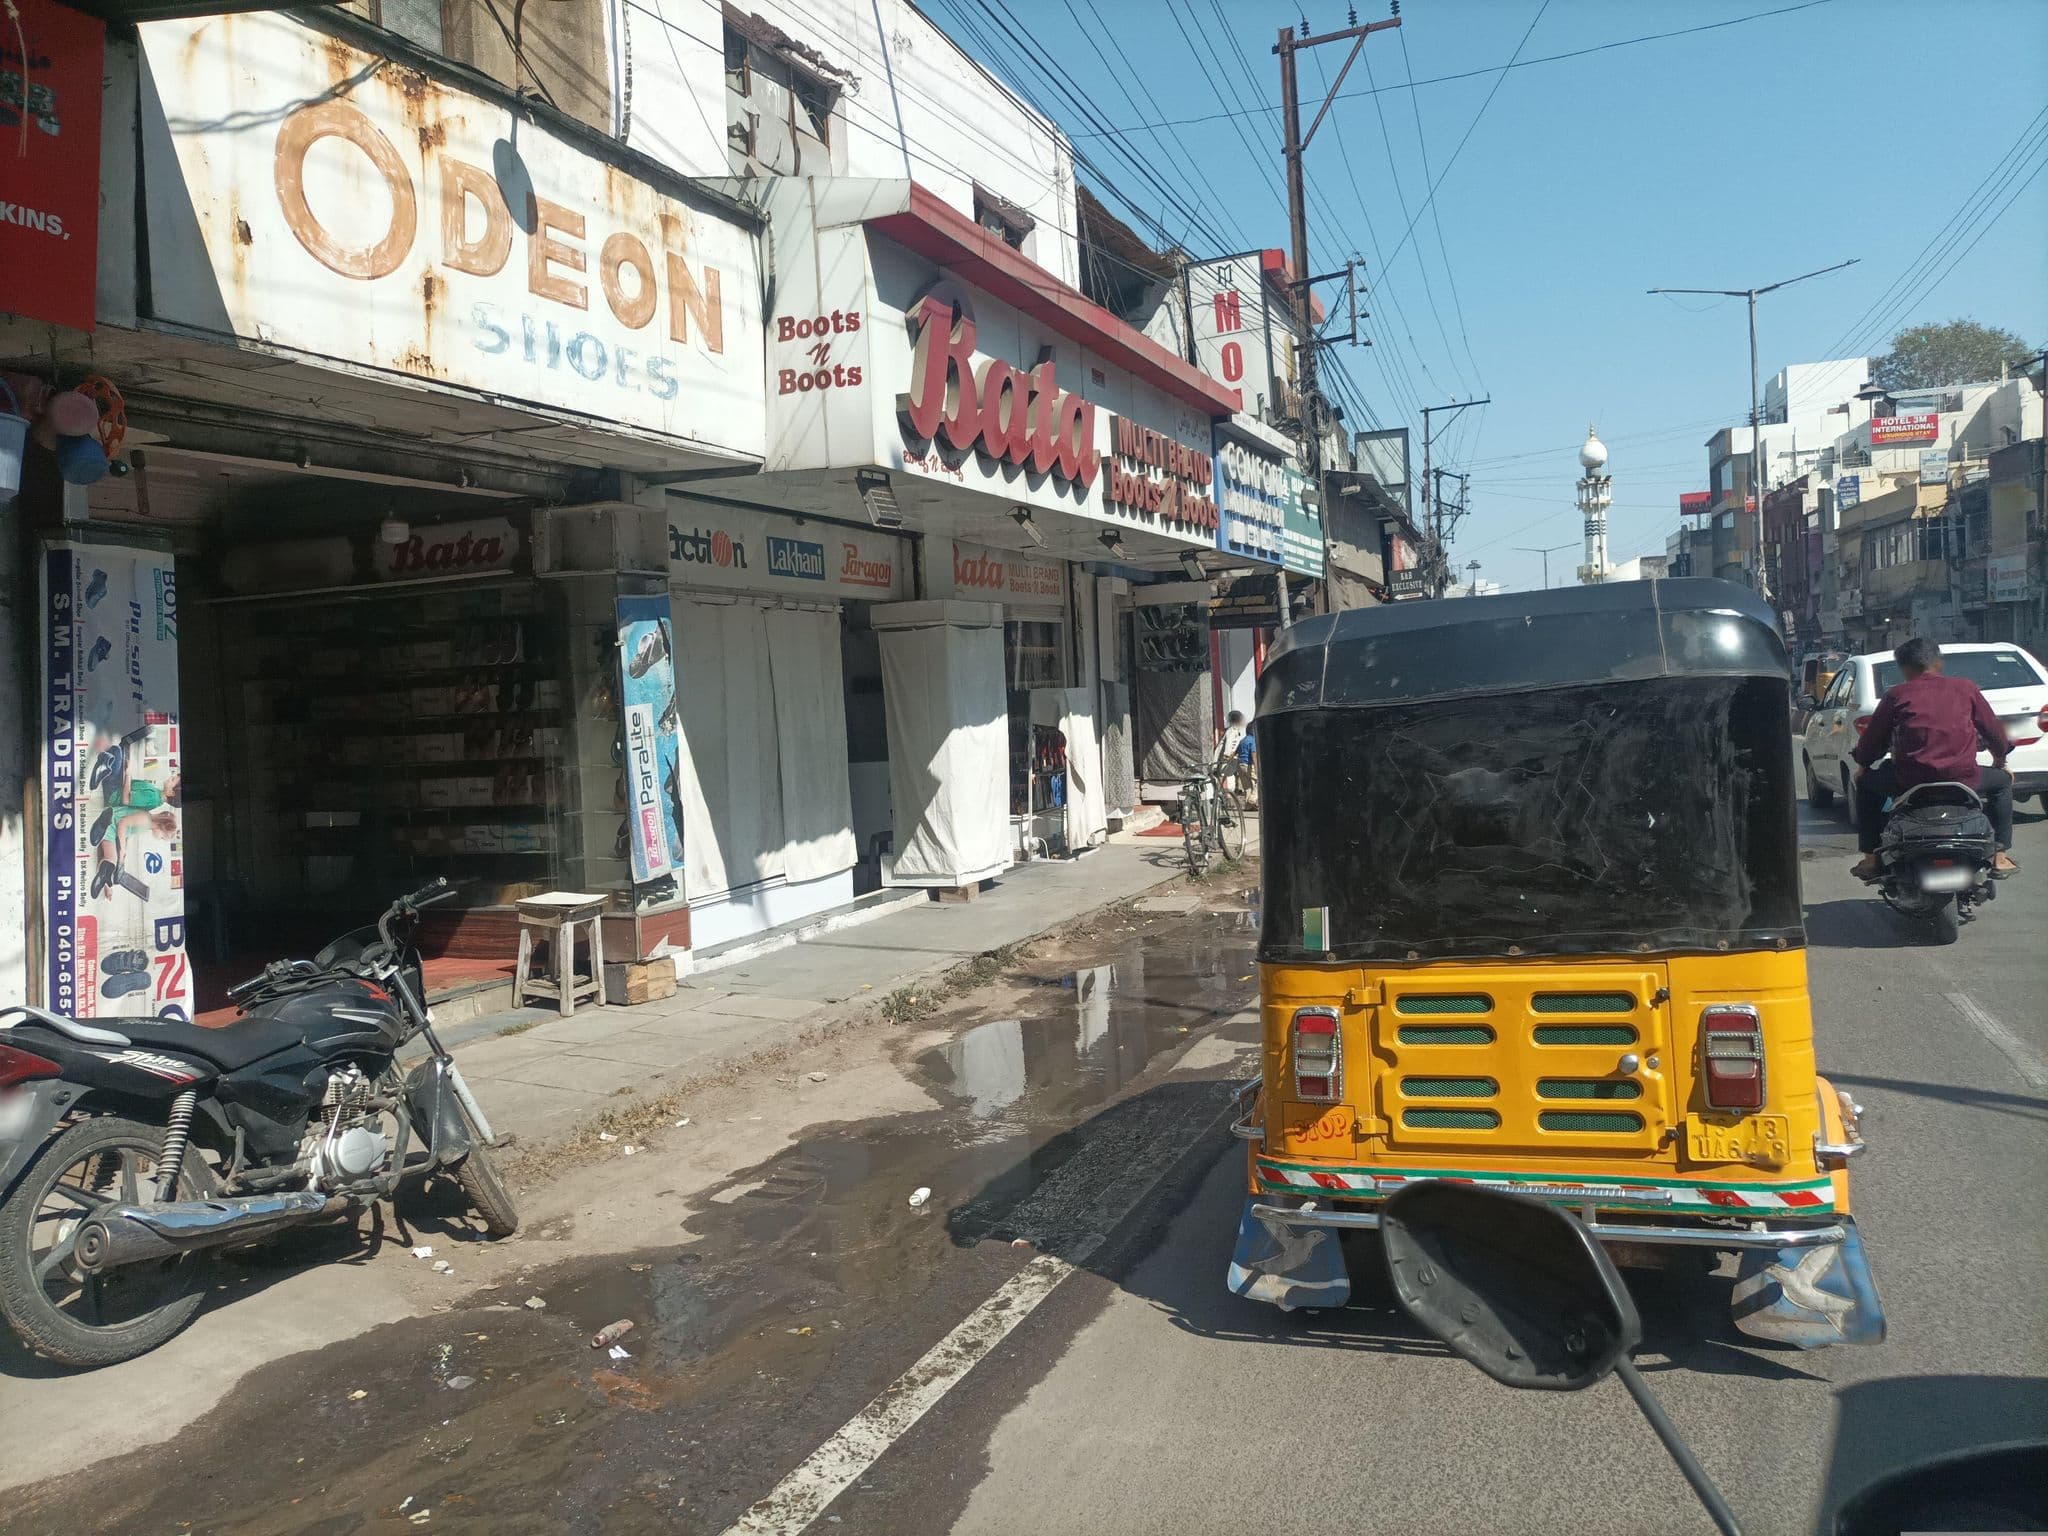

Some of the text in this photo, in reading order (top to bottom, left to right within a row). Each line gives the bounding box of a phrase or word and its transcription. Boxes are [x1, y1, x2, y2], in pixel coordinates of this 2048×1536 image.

[274, 98, 724, 355] ODEON
[778, 309, 860, 342] Boots
[779, 363, 862, 395] Boots
[897, 282, 1101, 490] Bata
[1872, 423, 1937, 433] INTERNATIONAL
[1881, 416, 1911, 426] HOTEL
[1117, 415, 1165, 470] MULTI
[1168, 440, 1213, 486] BRAND
[1109, 456, 1160, 514] Boots
[1180, 479, 1219, 529] Boots
[390, 531, 504, 571] Bata
[770, 540, 823, 576] Lakhani
[841, 542, 891, 586] Paragon
[1008, 561, 1059, 582] MULTI BRAND
[1009, 578, 1032, 593] Boots
[162, 570, 178, 641] BOYZ
[53, 593, 72, 831] S.M. TRADER'S
[630, 711, 654, 805] ParaLite
[79, 837, 87, 852] Belly
[644, 811, 660, 863] Paragon
[57, 876, 71, 901] Ph
[108, 1049, 192, 1068] Shine
[1294, 1113, 1347, 1143] STOP
[1750, 1118, 1777, 1140] 13
